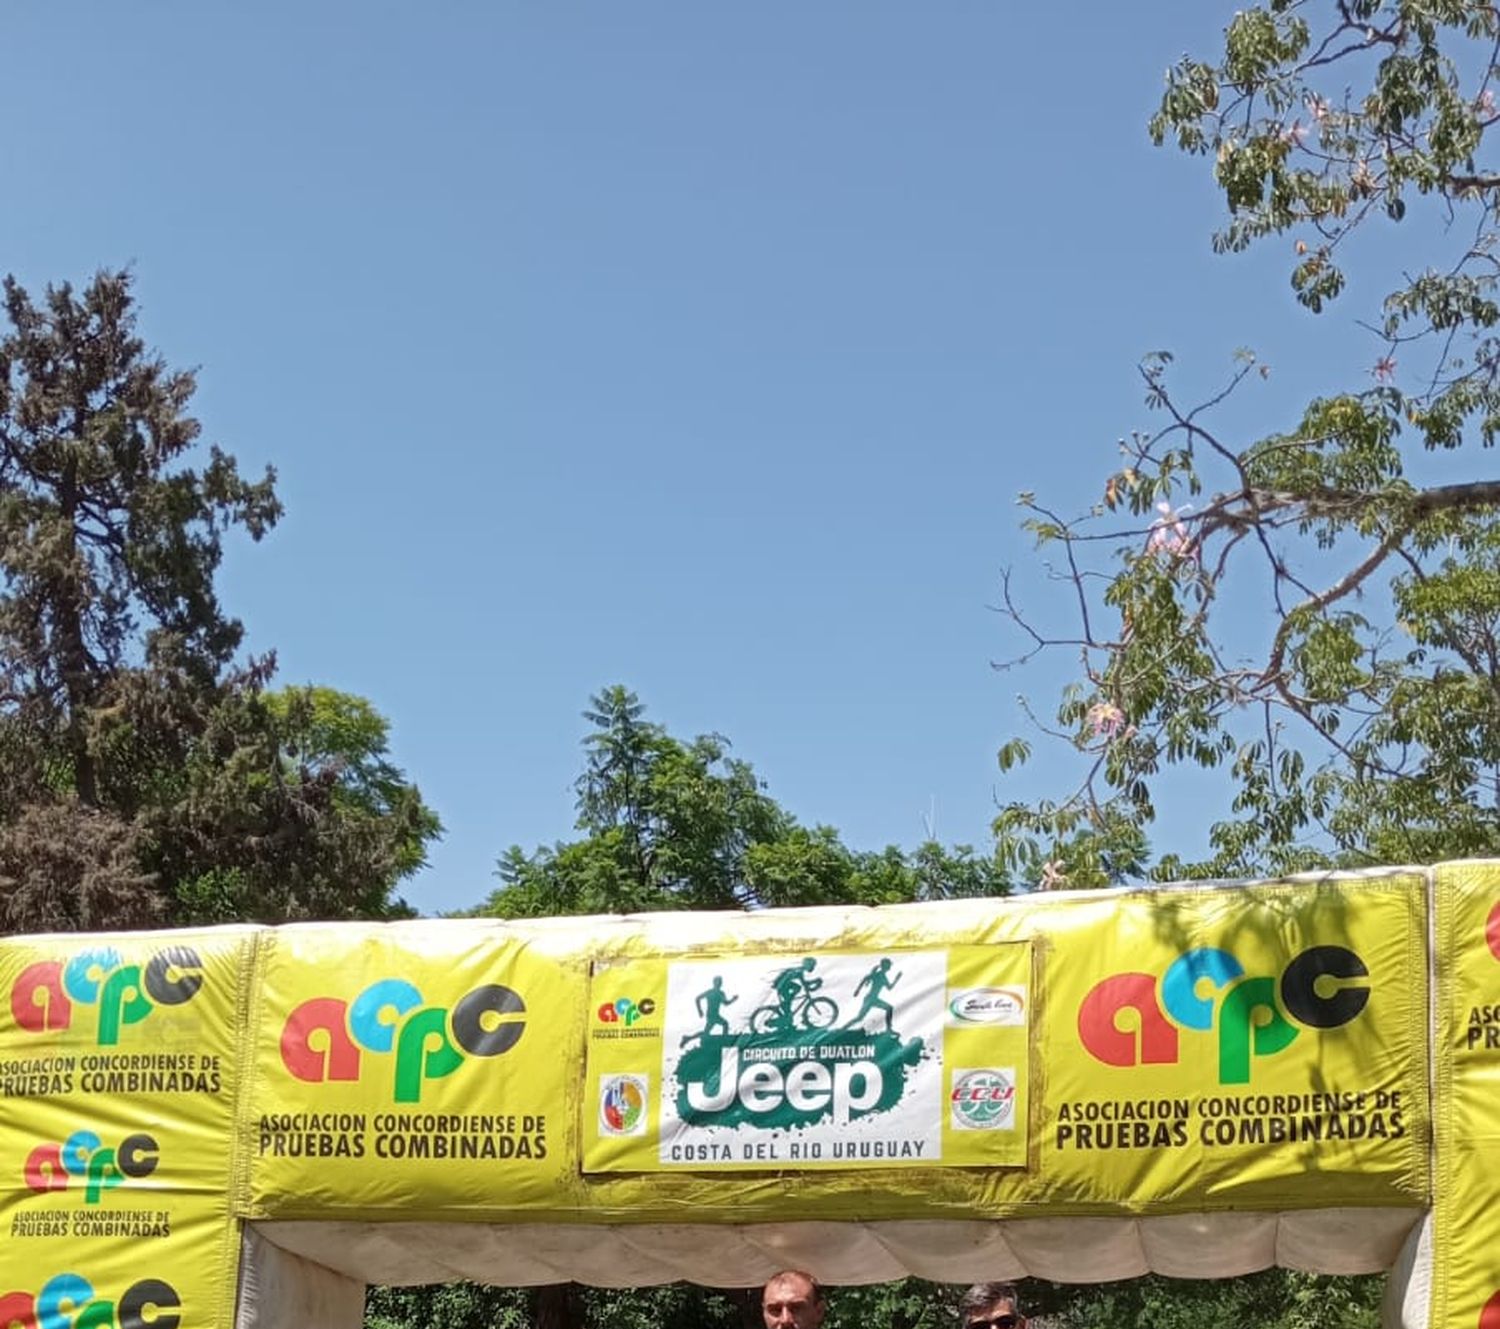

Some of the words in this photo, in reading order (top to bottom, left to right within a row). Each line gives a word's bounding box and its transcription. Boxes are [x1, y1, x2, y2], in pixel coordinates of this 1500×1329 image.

[81, 1054, 195, 1072] CONCORDIENSE
[200, 1055, 220, 1071] DE
[743, 1047, 796, 1062] CIRCUITO
[801, 1046, 816, 1059] DE
[820, 1045, 875, 1059] DUATLON
[0, 1072, 74, 1097] RUEBAS
[81, 1071, 220, 1094] COMBINADAS
[687, 1046, 883, 1124] Jeep
[1058, 1100, 1189, 1123] ASOCIACION
[1197, 1092, 1367, 1120] CONCORDIENSE
[1376, 1090, 1401, 1111] DE
[260, 1113, 366, 1133] ASOCIACION
[373, 1113, 519, 1134] CONCORDIENSE
[522, 1115, 546, 1134] DE
[1056, 1122, 1189, 1150] PRUEBAS
[1200, 1111, 1404, 1148] COMBINADAS
[259, 1134, 365, 1159] PRUEBAS
[374, 1133, 547, 1160] COMBINADAS
[672, 1143, 732, 1161] COSTA
[744, 1143, 778, 1160] DEL
[789, 1142, 822, 1159] RIO
[832, 1140, 925, 1158] URUGUAY
[14, 1211, 70, 1223] ASOCIACION
[73, 1210, 154, 1223] CONCORDIENSE
[156, 1211, 170, 1223] DE
[11, 1222, 68, 1237] PRUEBAS
[73, 1221, 171, 1238] COMBINADAS
